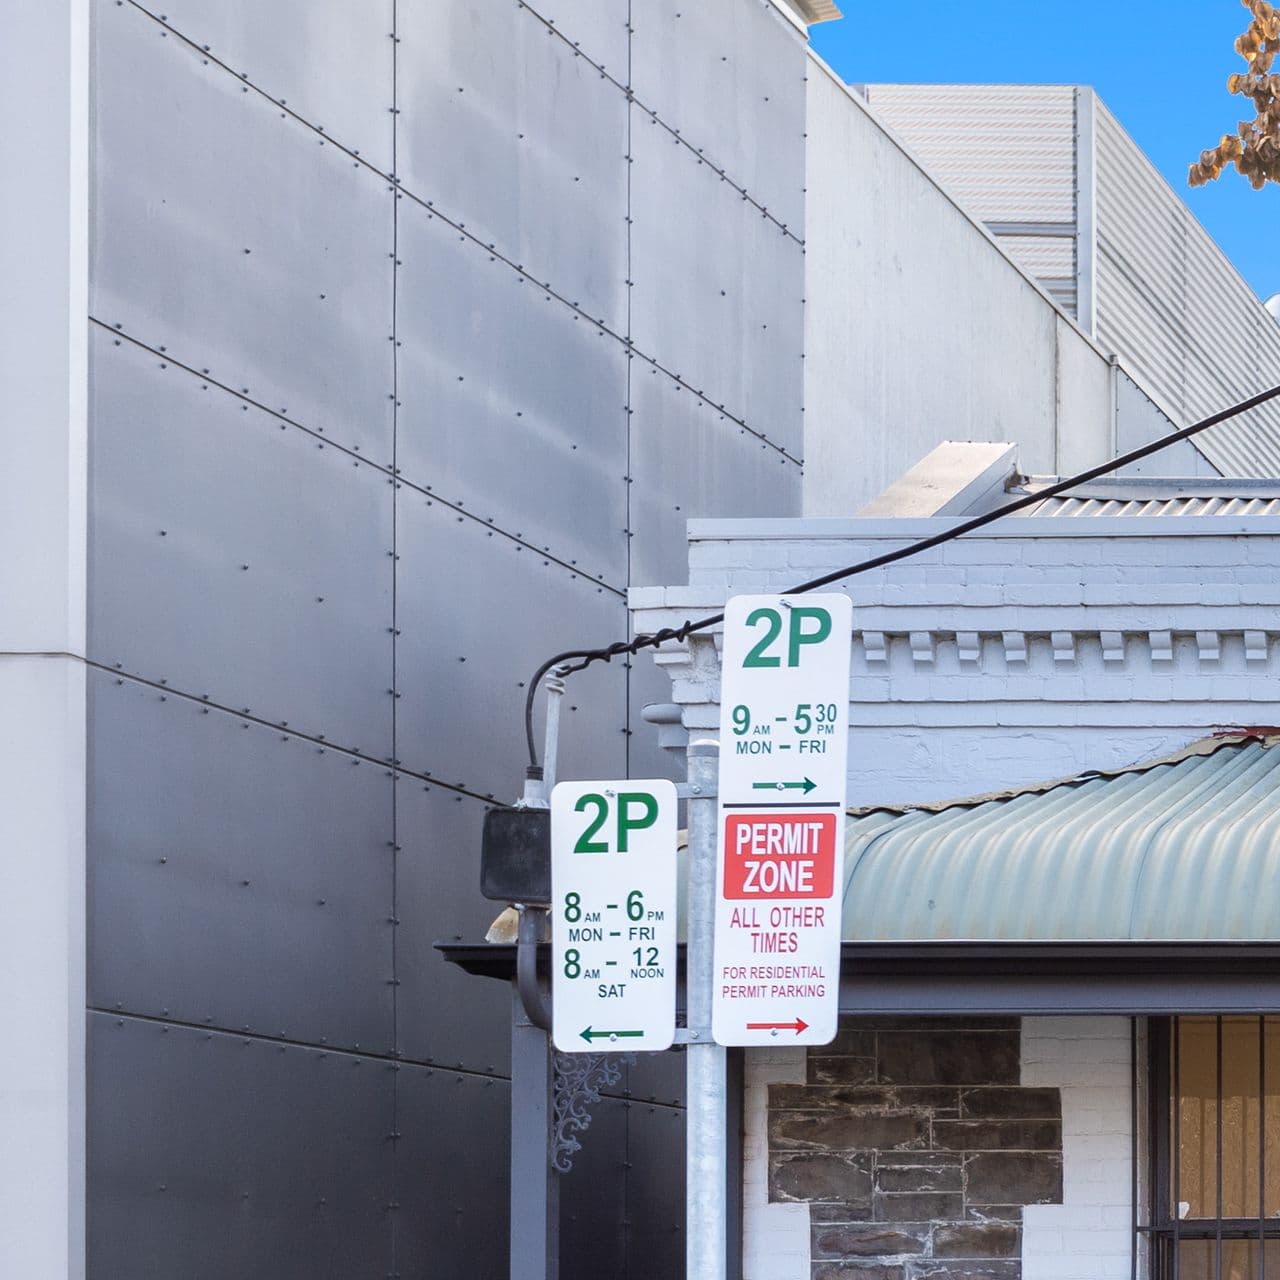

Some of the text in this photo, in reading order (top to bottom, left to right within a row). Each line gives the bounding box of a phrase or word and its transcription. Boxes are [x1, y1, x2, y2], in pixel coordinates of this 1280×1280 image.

[742, 606, 834, 669] 2P
[736, 740, 773, 755] MON
[799, 739, 827, 754] FRI
[573, 792, 660, 854] 2P
[735, 822, 825, 856] PERMIT
[742, 859, 815, 893] ZONE
[730, 905, 826, 930] ALL OTHER
[568, 927, 604, 942] MON
[628, 926, 656, 941] FRI
[750, 931, 799, 954] TIMES
[632, 946, 660, 967] 12
[630, 967, 665, 979] NOON
[723, 965, 827, 980] FOR RESIDENTIAL
[598, 983, 628, 999] SAT
[722, 984, 826, 999] PERMIT PARKING
